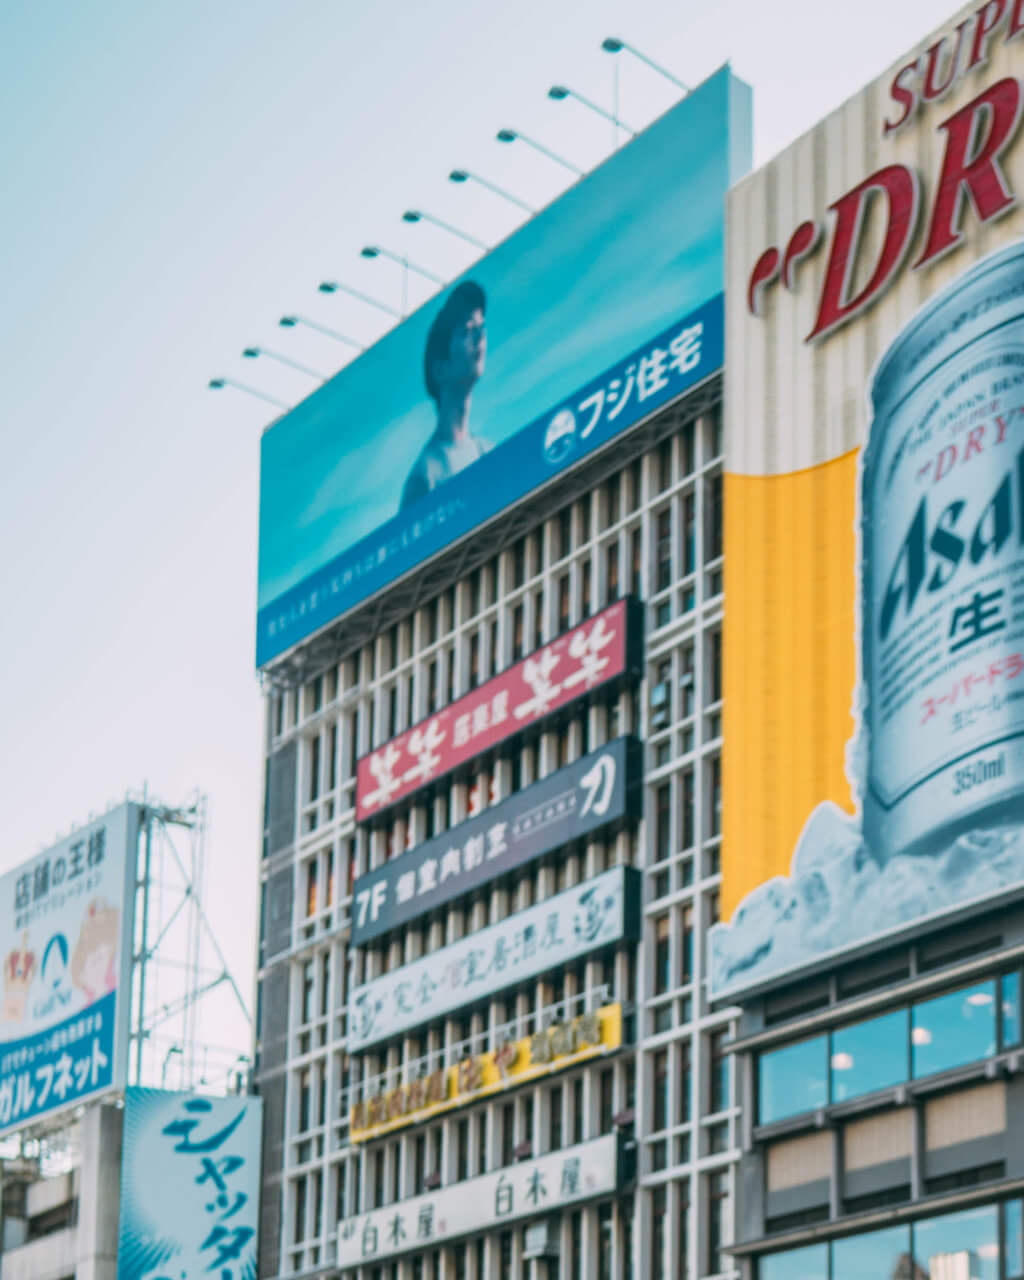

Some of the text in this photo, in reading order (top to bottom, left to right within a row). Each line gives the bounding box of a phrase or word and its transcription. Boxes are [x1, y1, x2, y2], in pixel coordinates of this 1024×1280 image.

[578, 322, 703, 440] フジ住宅
[949, 588, 1006, 652] 生
[580, 754, 616, 817] 刀
[952, 752, 1007, 795] 350ml
[15, 824, 107, 911] 店舗の王様
[357, 880, 388, 928] 7F
[494, 1156, 582, 1217] 白木屋
[362, 1202, 435, 1256] 白木屋
